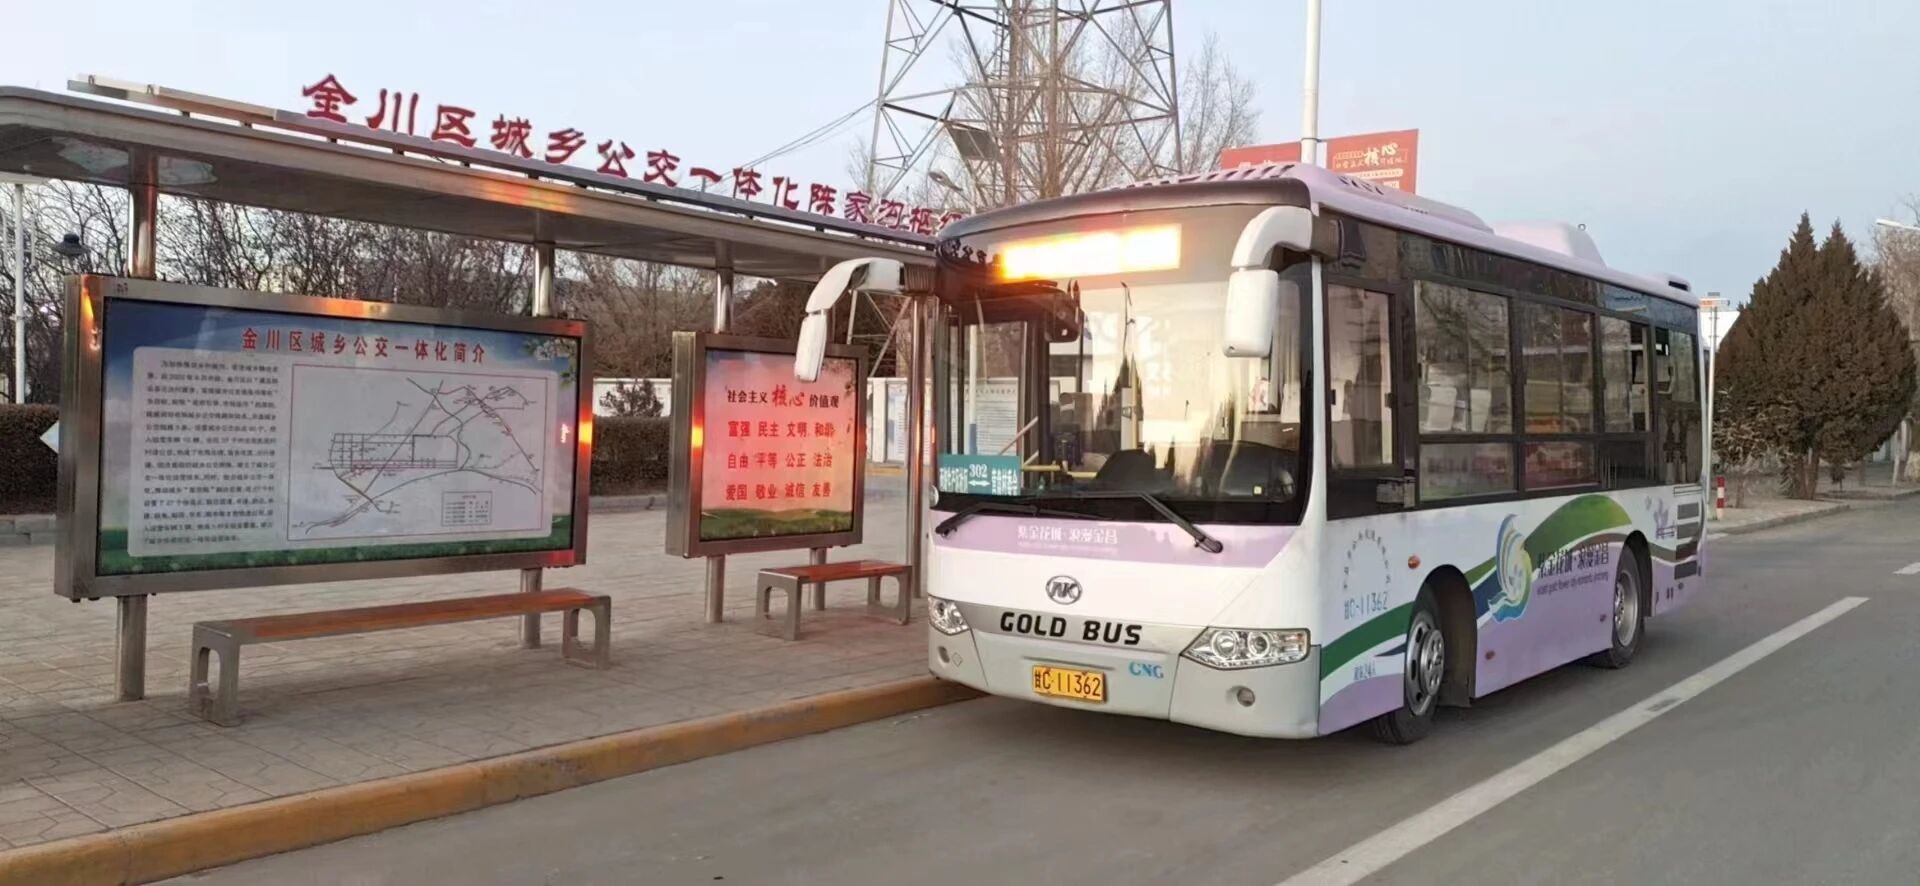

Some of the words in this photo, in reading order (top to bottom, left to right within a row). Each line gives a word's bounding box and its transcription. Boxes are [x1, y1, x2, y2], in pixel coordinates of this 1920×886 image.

[242, 328, 485, 364] 金川区城乡公交一体化简介
[727, 389, 768, 404] 社会主义
[771, 384, 805, 408] 核心
[808, 394, 840, 408] 价值观
[727, 421, 751, 437] 富强
[757, 421, 779, 437] 民主
[786, 421, 808, 438] 文明
[727, 453, 749, 469] 自由
[755, 452, 778, 468] 平等
[785, 452, 807, 468] 公正
[813, 452, 833, 468] 法治
[969, 463, 988, 478] 302
[726, 484, 748, 500] 爱国
[755, 483, 777, 500] 敬业
[784, 483, 806, 498] 诚信
[812, 482, 832, 497] 友善
[1001, 611, 1067, 637] GOLD
[1082, 620, 1142, 645] BUS
[1129, 661, 1164, 679] CNG
